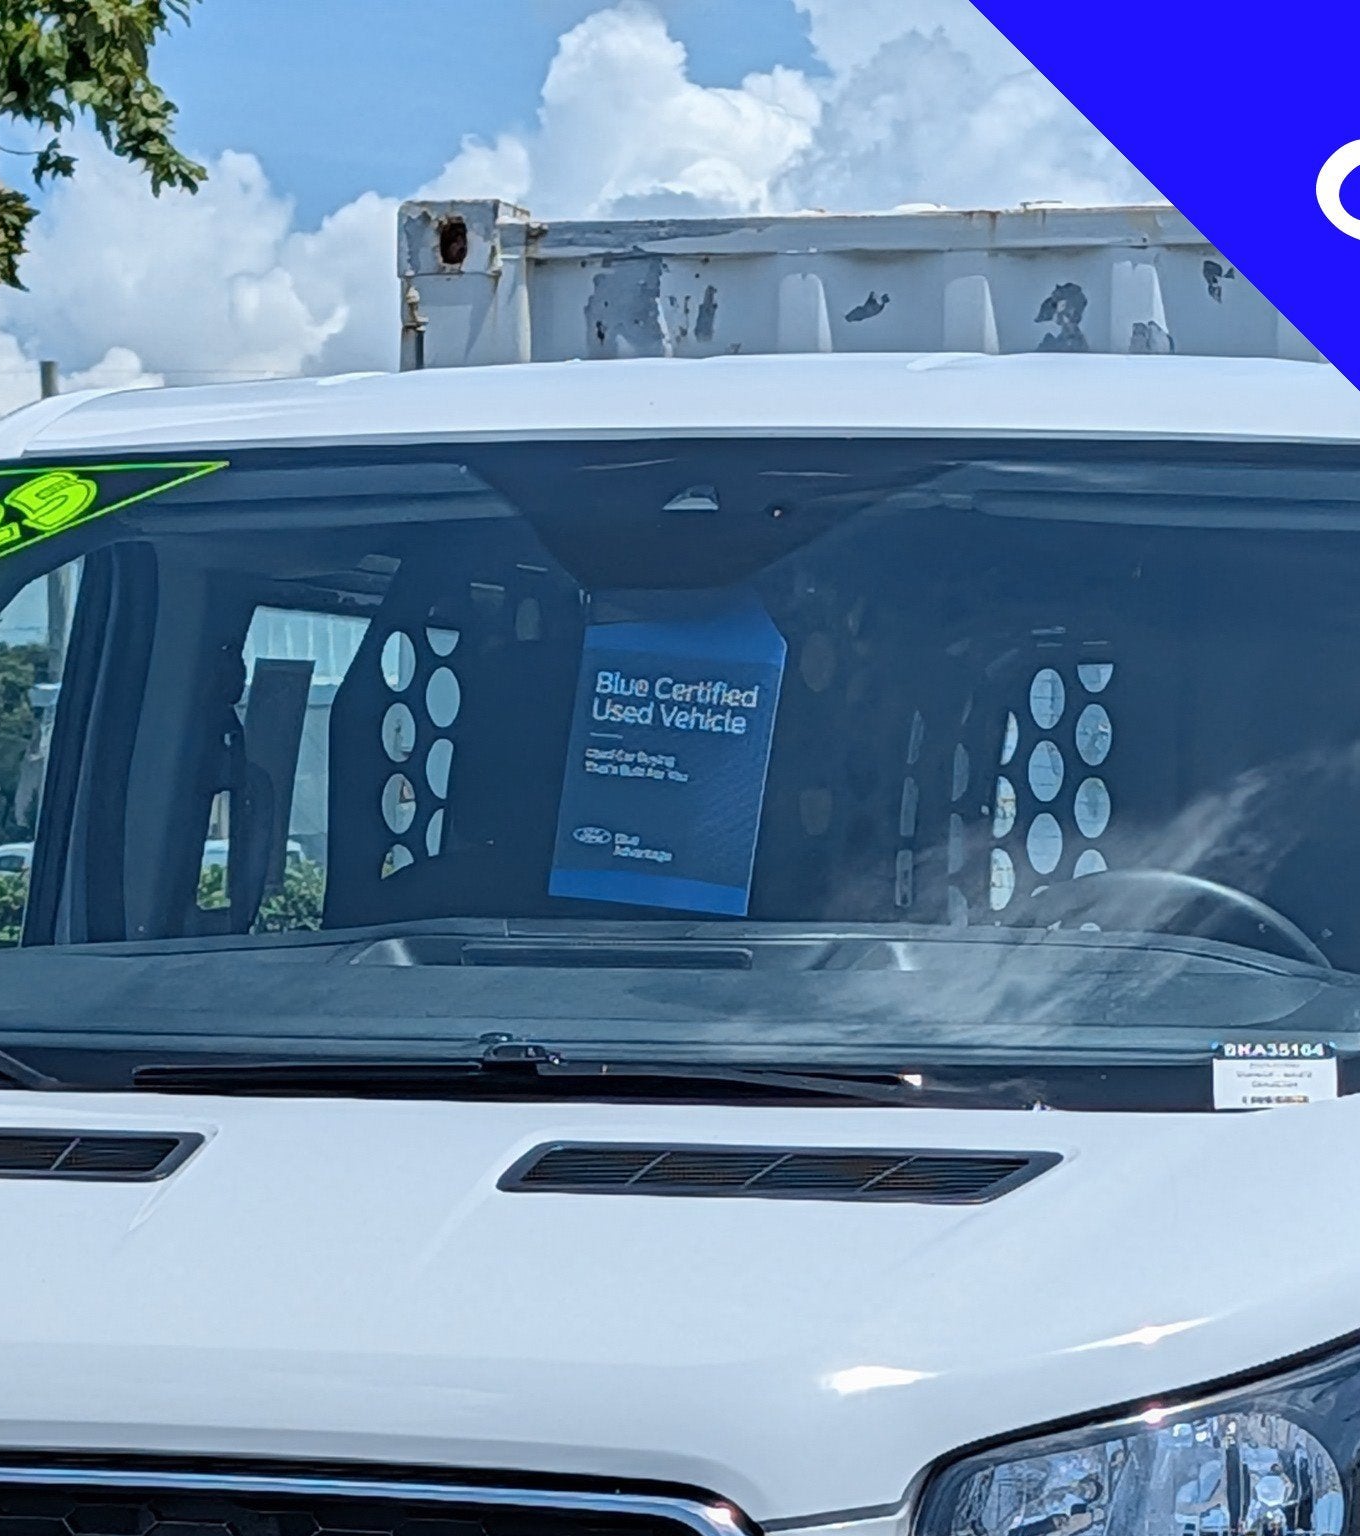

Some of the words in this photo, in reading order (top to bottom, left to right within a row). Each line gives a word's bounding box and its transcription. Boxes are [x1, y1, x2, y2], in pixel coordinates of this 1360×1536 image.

[595, 670, 649, 698] Blue
[654, 676, 759, 708] Certified
[592, 696, 654, 726] Used
[660, 704, 748, 736] Vehicle
